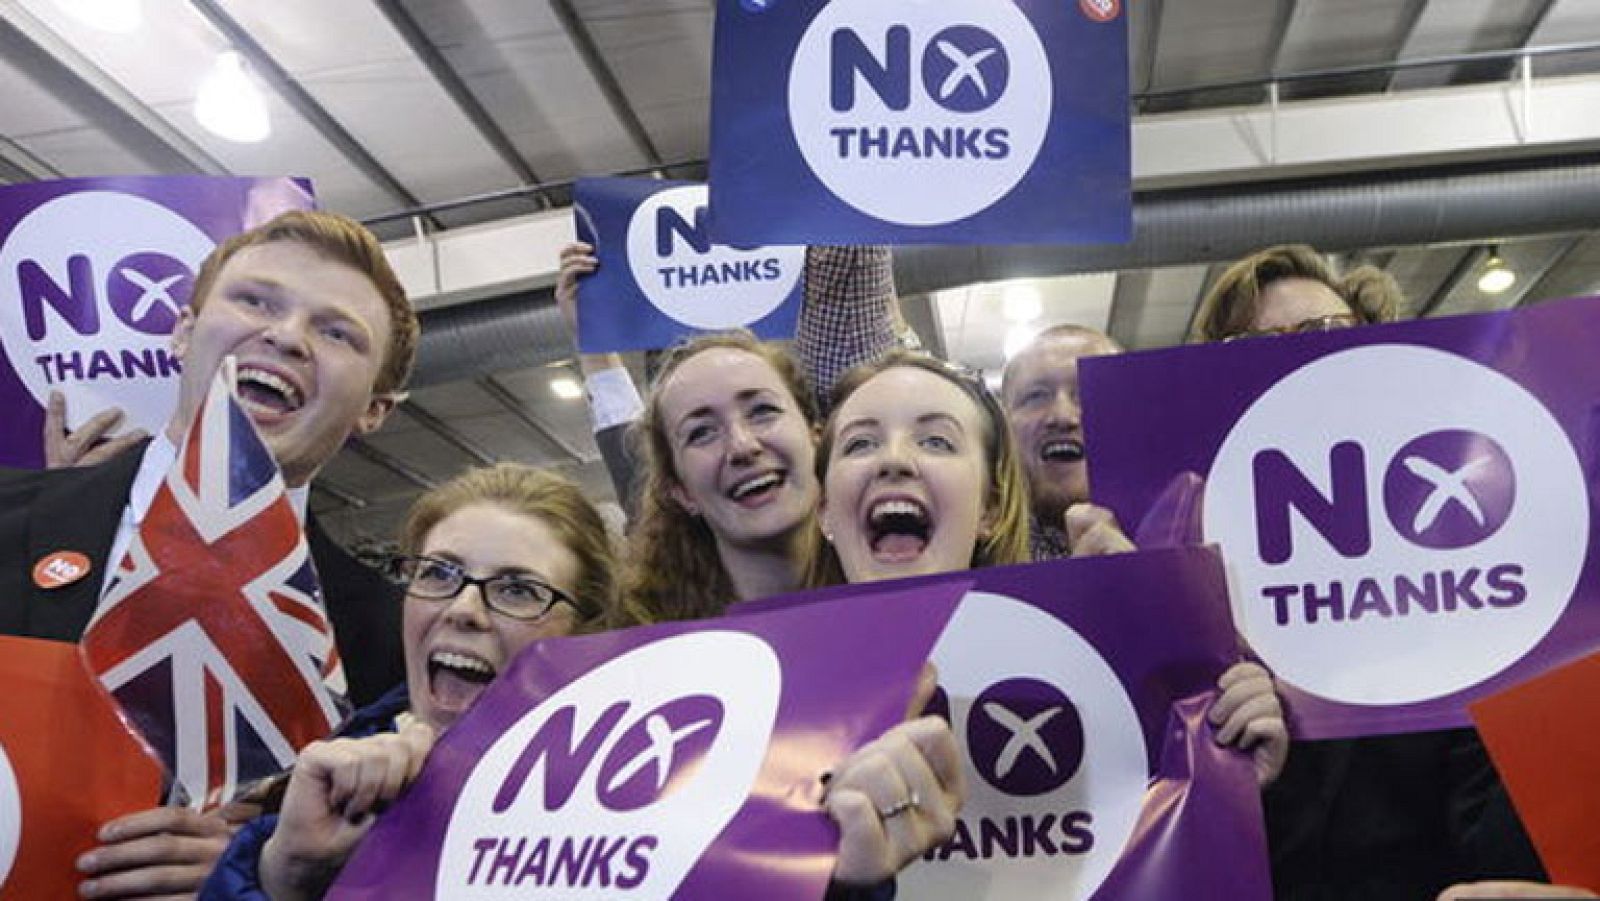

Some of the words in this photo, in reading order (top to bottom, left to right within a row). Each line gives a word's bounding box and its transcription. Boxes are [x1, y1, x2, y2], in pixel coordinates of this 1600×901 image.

[831, 24, 1010, 113] NO
[830, 127, 1010, 159] THANKS
[17, 252, 194, 340] NO
[658, 258, 781, 288] THANKS
[36, 349, 182, 383] THANK
[1252, 428, 1517, 565] NO
[1262, 564, 1528, 626] THANKS
[491, 694, 725, 814] NO
[467, 835, 659, 889] THANKS
[924, 811, 1095, 861] ANKS
